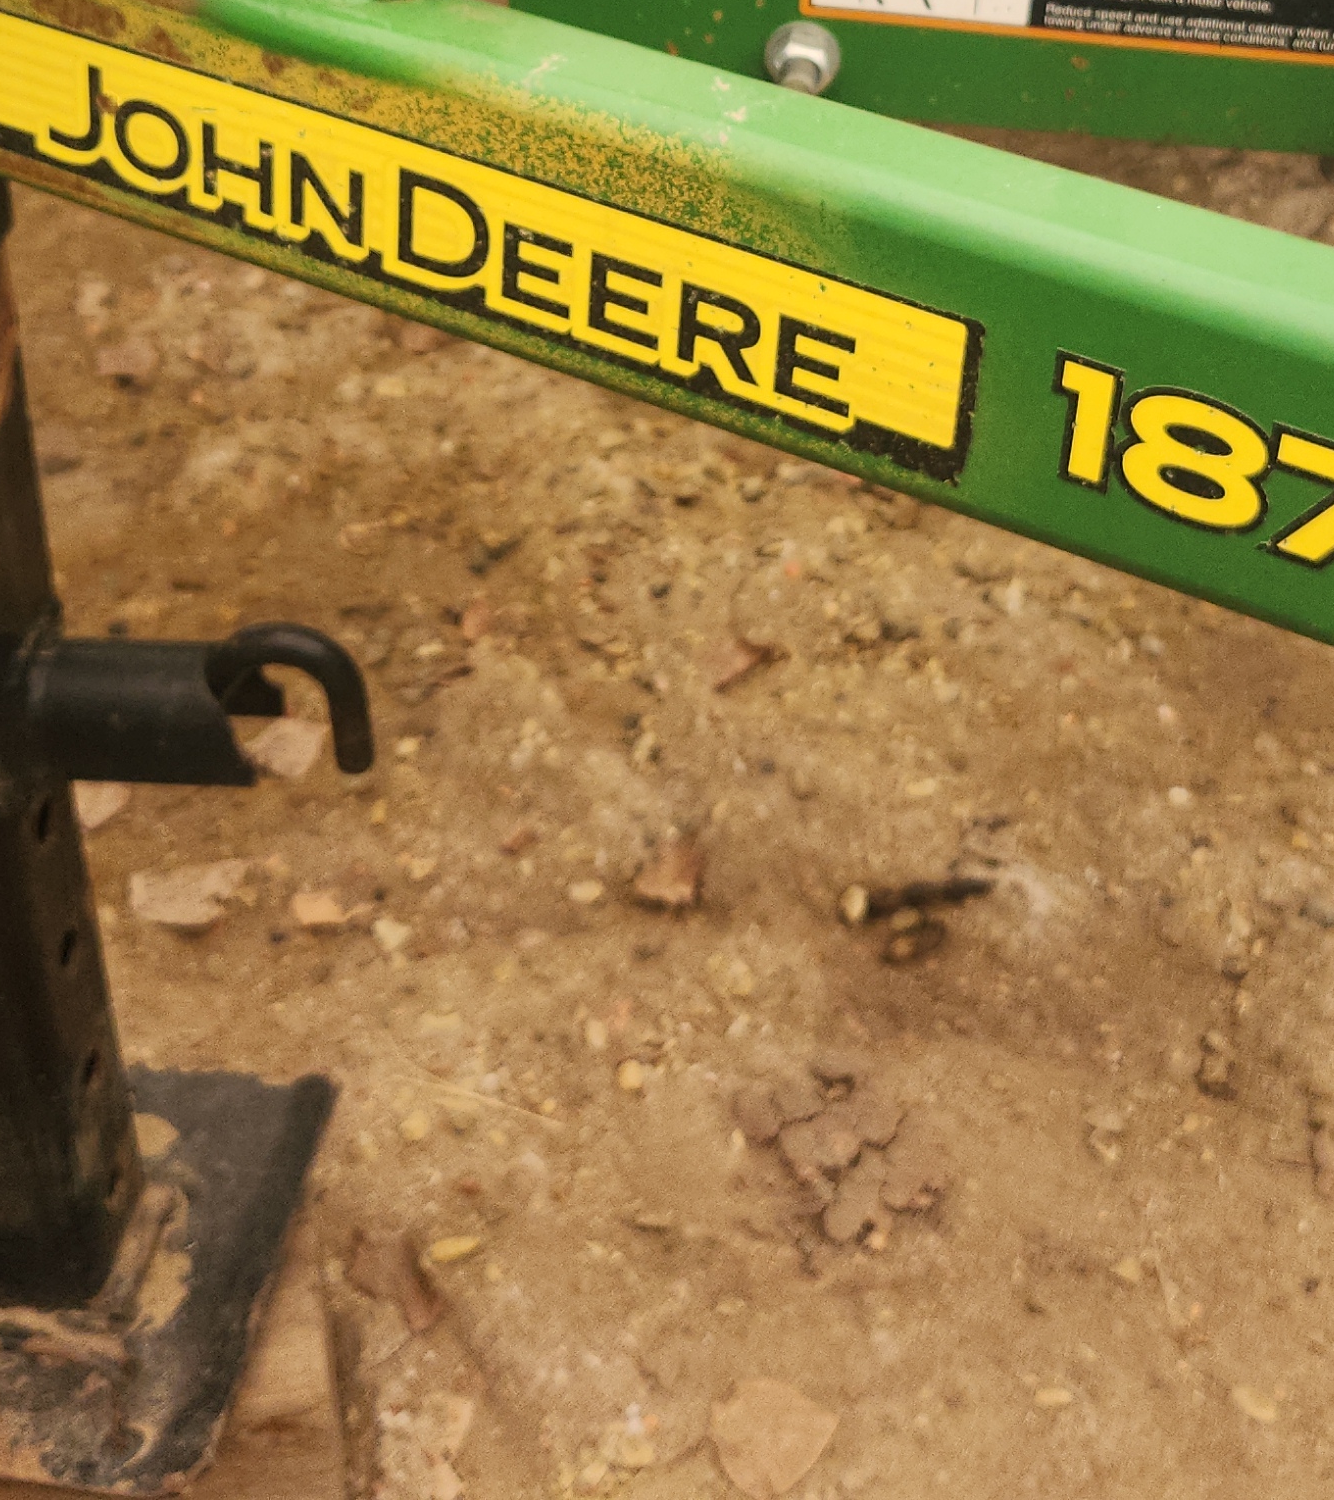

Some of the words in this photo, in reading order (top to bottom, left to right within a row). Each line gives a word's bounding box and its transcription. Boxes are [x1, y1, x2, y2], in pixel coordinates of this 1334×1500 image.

[1045, 2, 1092, 18] Reduce
[1094, 8, 1132, 22] speed
[1134, 13, 1158, 25] and
[1161, 15, 1184, 27] use
[1186, 16, 1244, 32] additional
[1248, 22, 1294, 37] caution
[1296, 26, 1330, 40] when
[1086, 19, 1121, 32] under
[1123, 23, 1173, 37] adverse
[1175, 28, 1221, 42] surface
[1292, 38, 1316, 50] and
[47, 66, 365, 248] JOHN
[396, 167, 857, 419] DEERE
